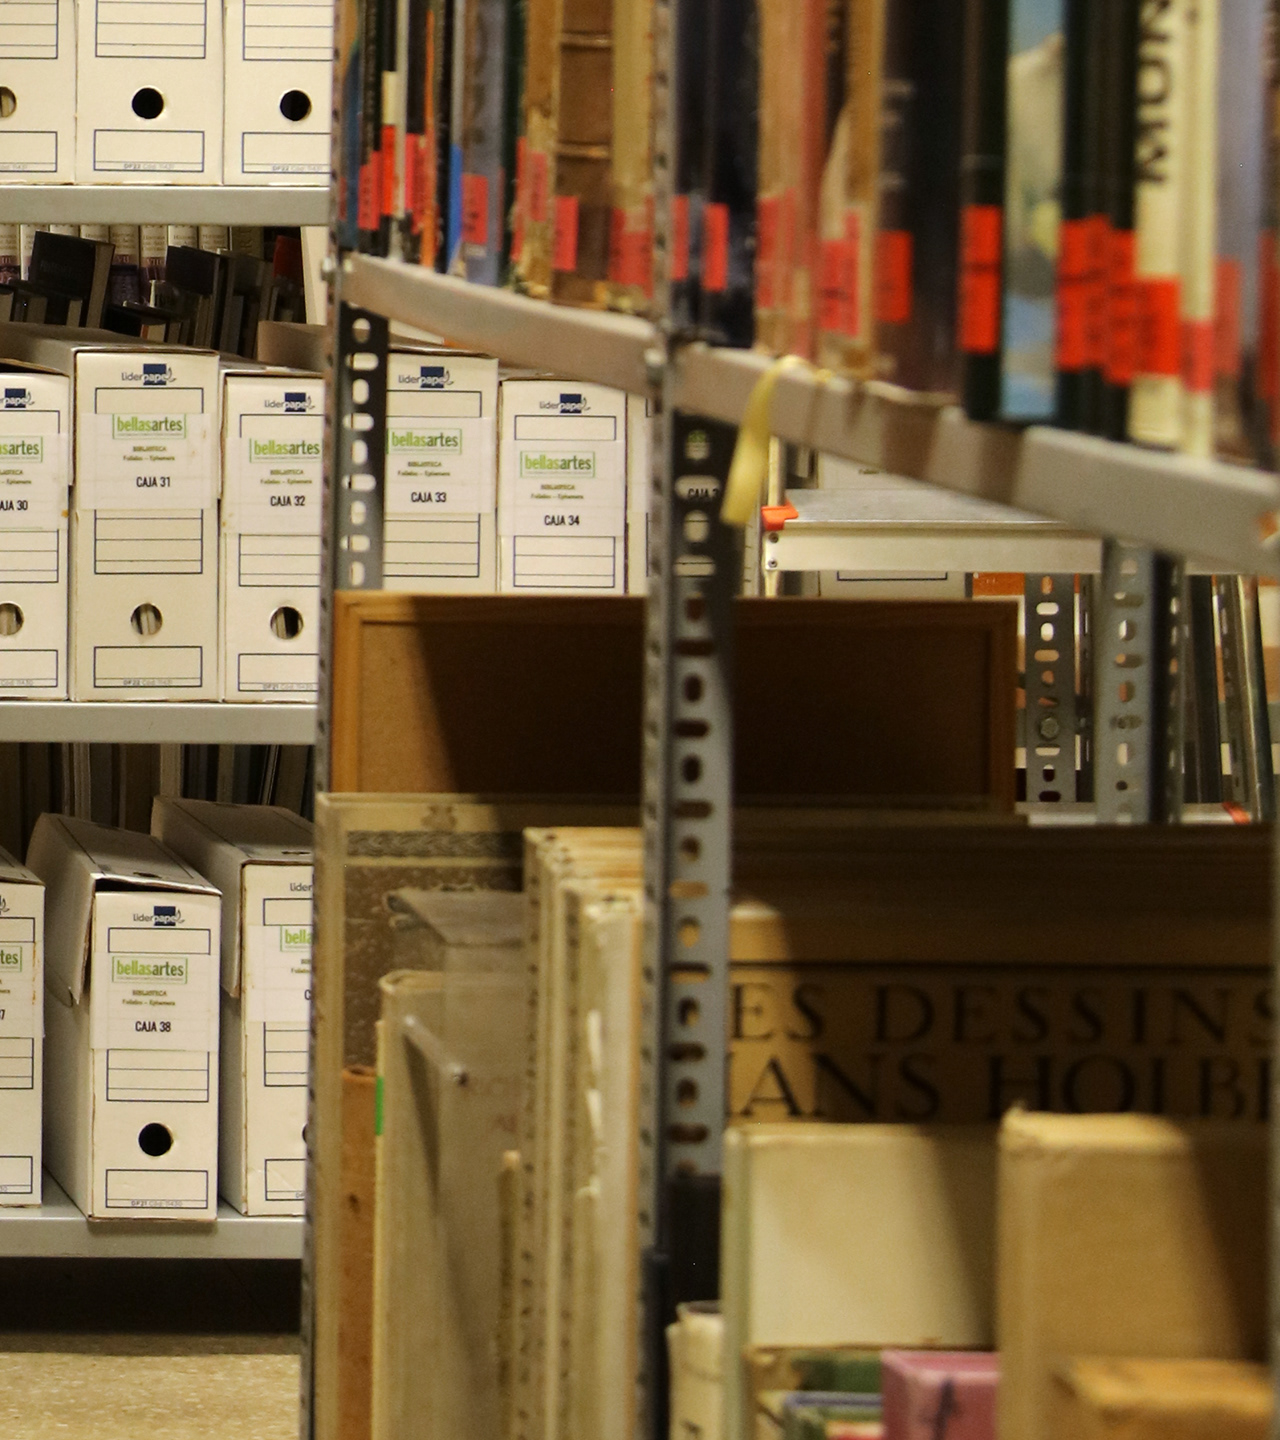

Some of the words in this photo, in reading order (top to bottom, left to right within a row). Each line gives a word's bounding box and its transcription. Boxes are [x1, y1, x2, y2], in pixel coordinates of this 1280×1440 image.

[117, 416, 182, 434] bellasartes
[391, 430, 458, 449] bellasartes
[254, 439, 319, 458] bellasartes
[525, 454, 591, 472] bellasartes
[136, 476, 157, 488] CAJA
[160, 476, 170, 488] 31
[17, 499, 28, 511] 30
[270, 495, 291, 506] CAJA
[294, 495, 306, 506] 32
[411, 492, 431, 503] CAJA
[435, 492, 446, 503] 33
[544, 515, 565, 526] CAJA
[568, 515, 579, 526] 34
[117, 959, 184, 976] bellasartes
[730, 982, 829, 1043] ES
[135, 1021, 156, 1032] CAJA
[159, 1021, 171, 1032] 38
[730, 1051, 939, 1120] ANS
